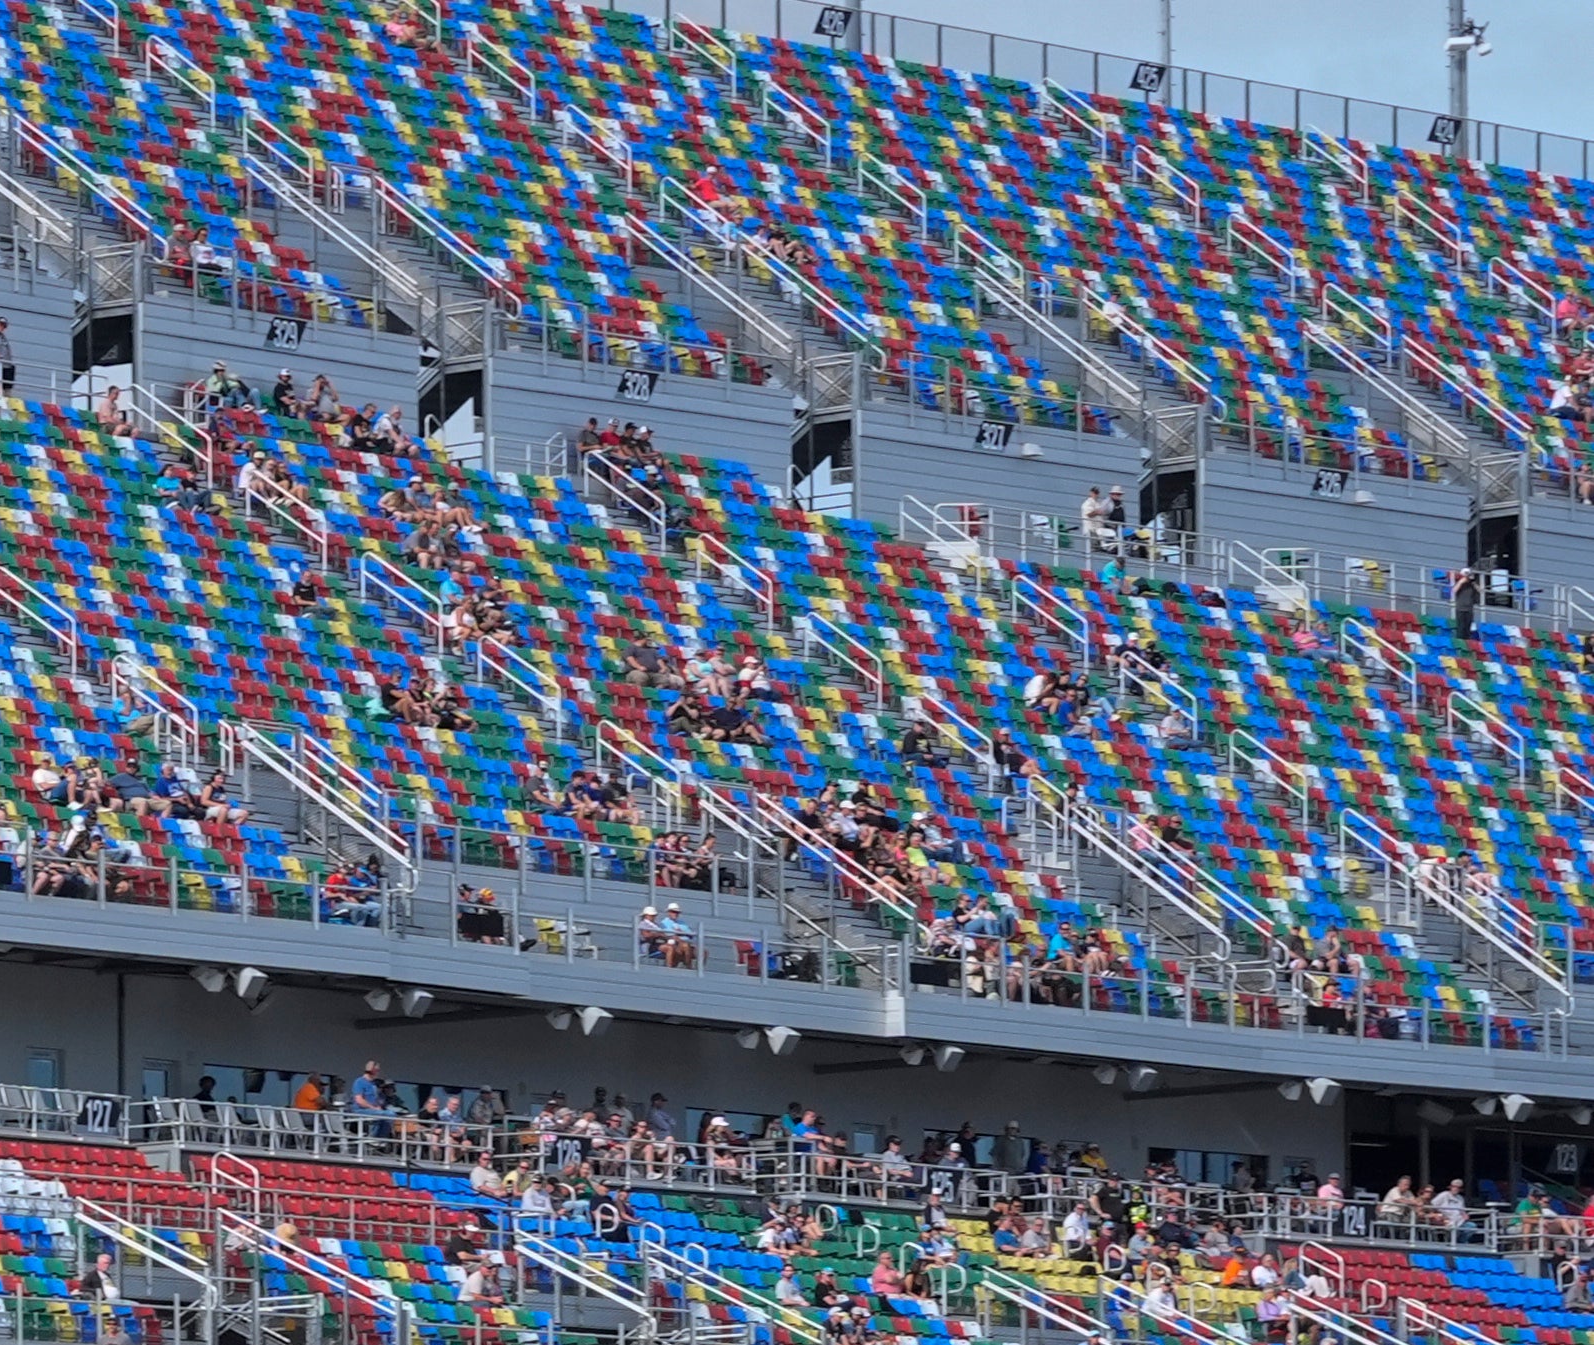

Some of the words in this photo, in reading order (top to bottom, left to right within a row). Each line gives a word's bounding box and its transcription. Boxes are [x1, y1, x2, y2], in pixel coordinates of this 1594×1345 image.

[274, 319, 298, 350] 329
[625, 371, 650, 401] 328
[982, 421, 1004, 451] 327
[1317, 471, 1341, 500] 326
[86, 1099, 110, 1133] 127
[557, 1139, 581, 1168] 126
[1556, 1144, 1577, 1172] 123
[1343, 1205, 1366, 1236] 124
